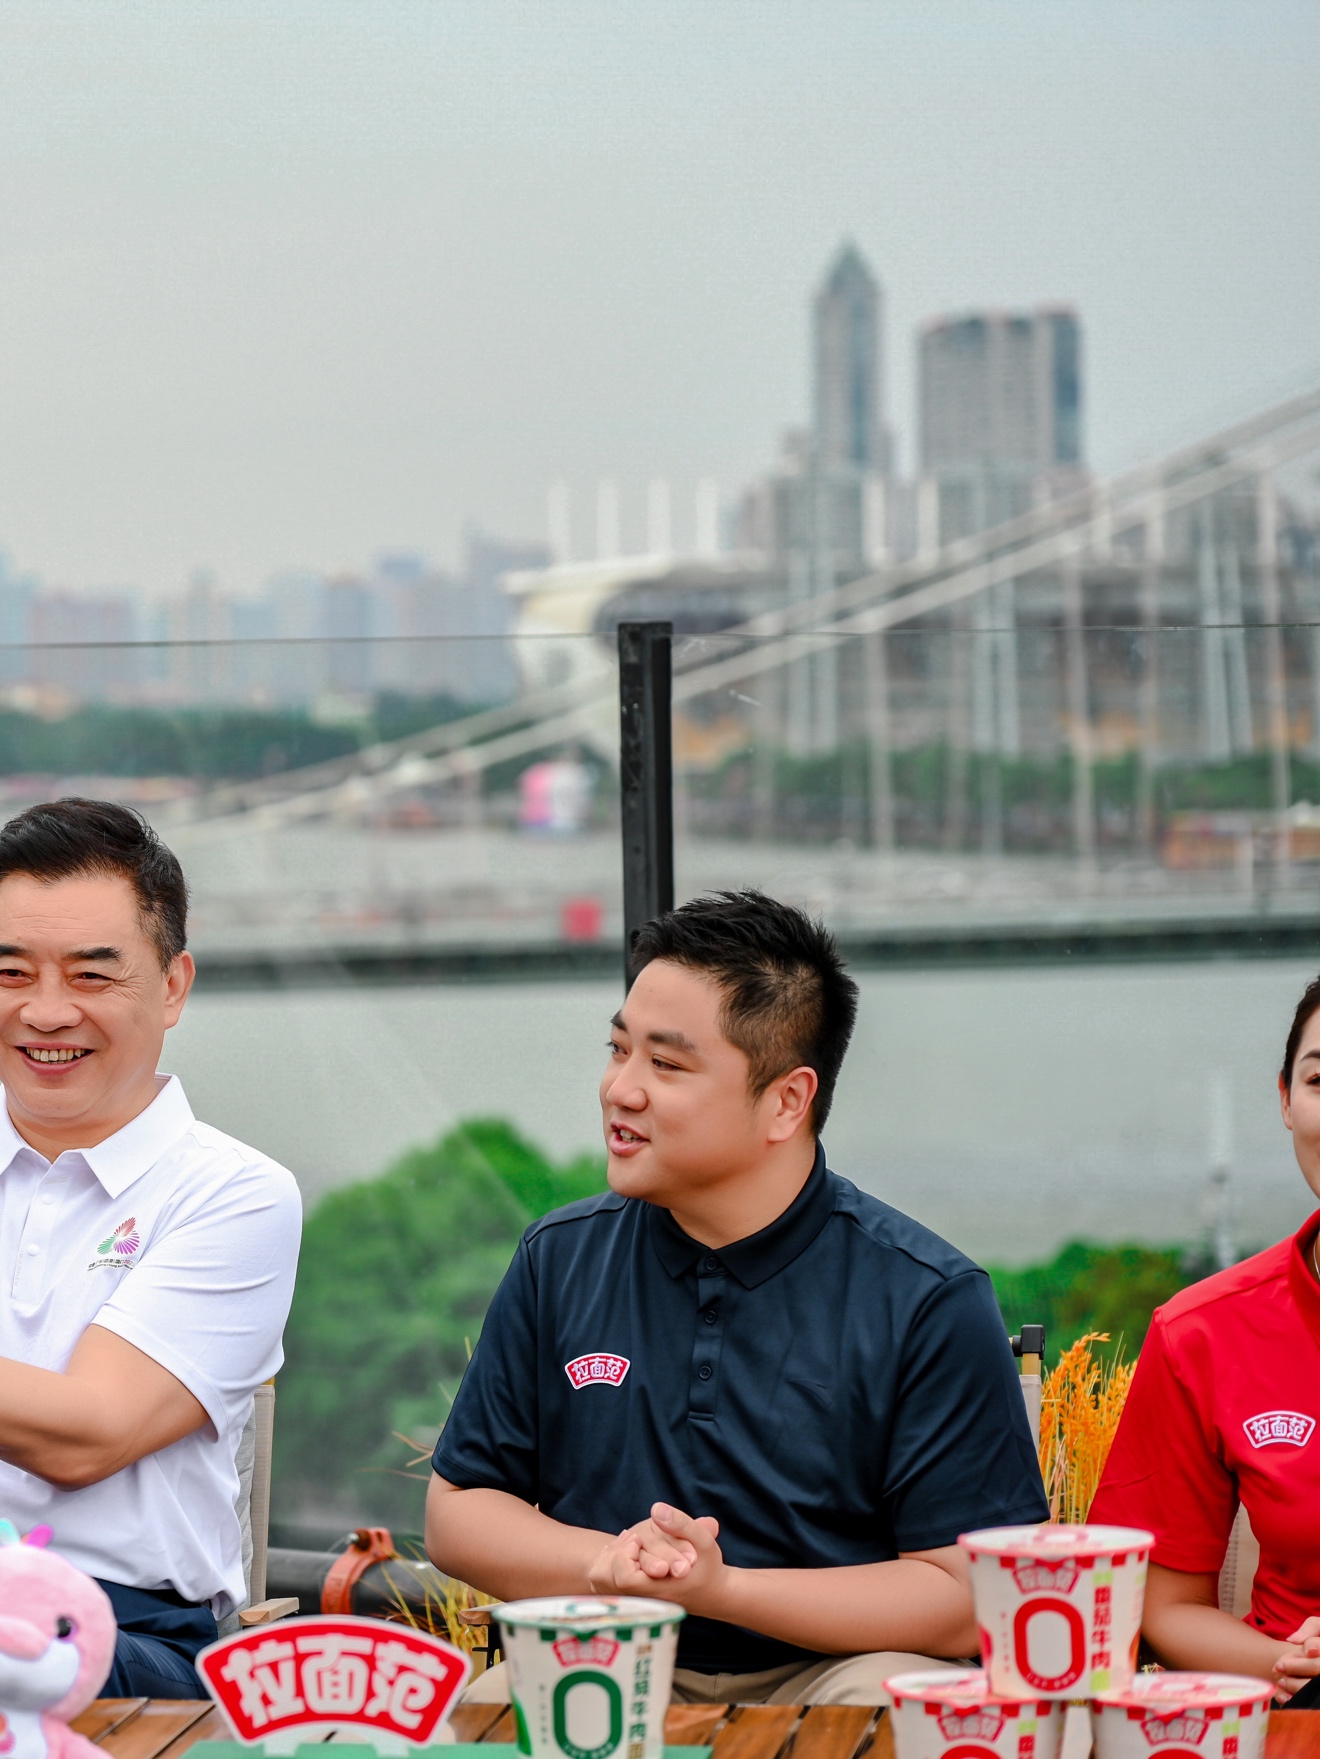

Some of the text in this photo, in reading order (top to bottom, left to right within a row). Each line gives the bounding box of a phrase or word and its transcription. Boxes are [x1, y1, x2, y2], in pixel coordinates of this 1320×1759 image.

[571, 1357, 624, 1383] 拉面范
[1249, 1416, 1308, 1443] 拉面范
[220, 1633, 449, 1729] 拉面范
